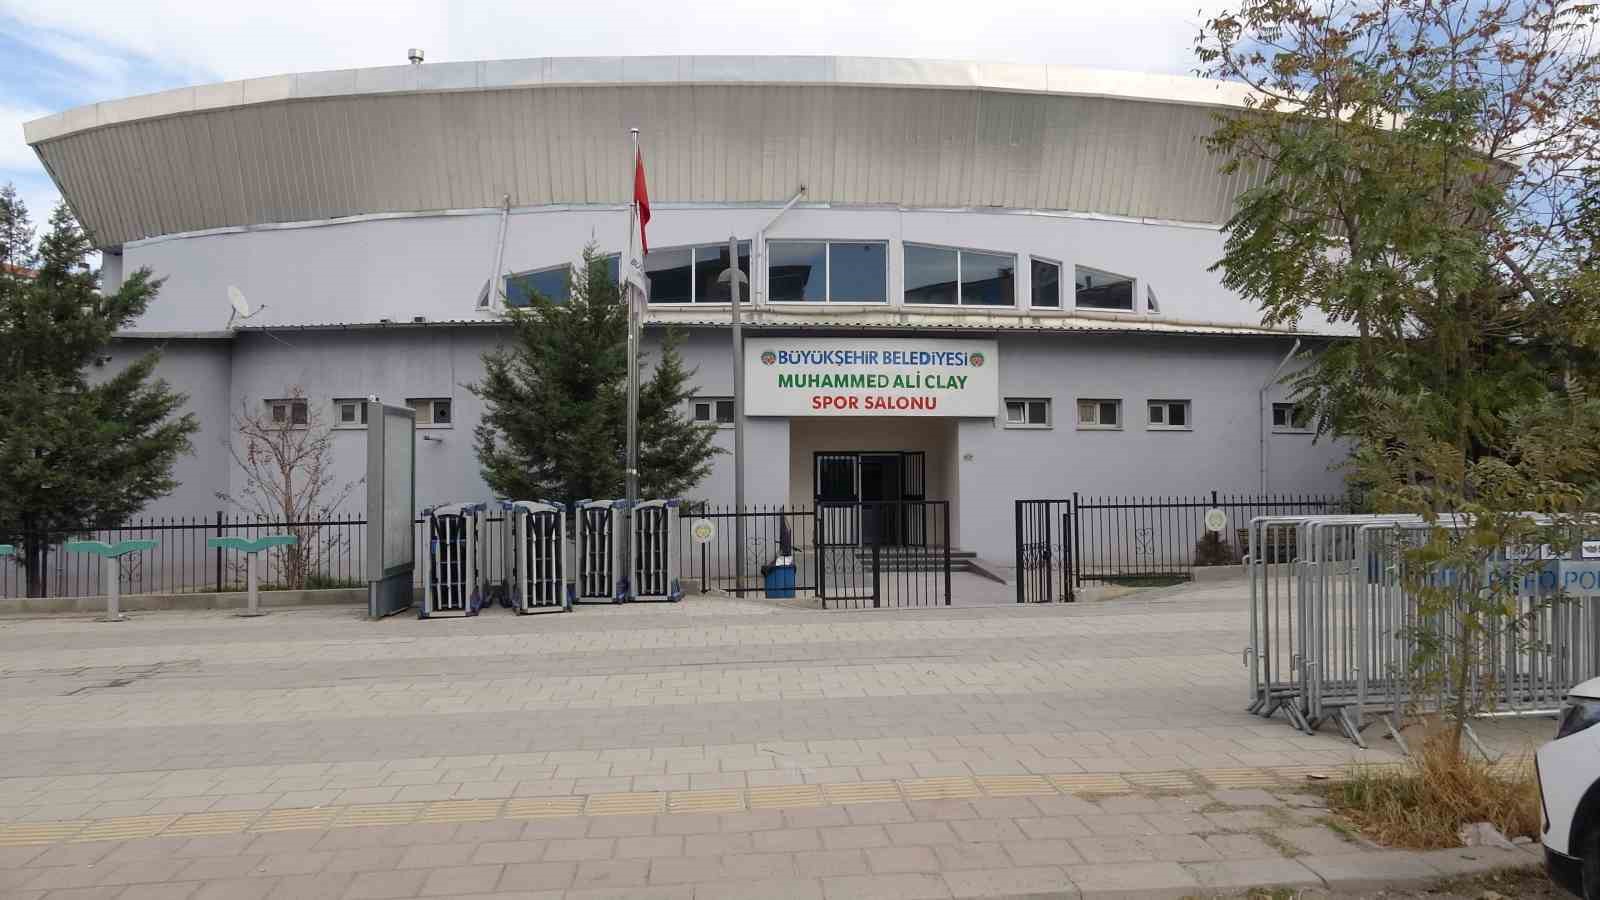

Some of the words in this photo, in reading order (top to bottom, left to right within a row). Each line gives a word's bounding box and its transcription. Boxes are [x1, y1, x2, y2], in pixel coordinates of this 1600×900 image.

[778, 350, 878, 367] BÜYÜKŞEHİR
[883, 351, 968, 366] BELEDİYESİ
[778, 374, 889, 388] MUHAMMED
[893, 371, 920, 388] ALİ
[925, 375, 968, 389] CLAY
[812, 396, 858, 409] SPOR
[865, 397, 937, 410] SALONU
